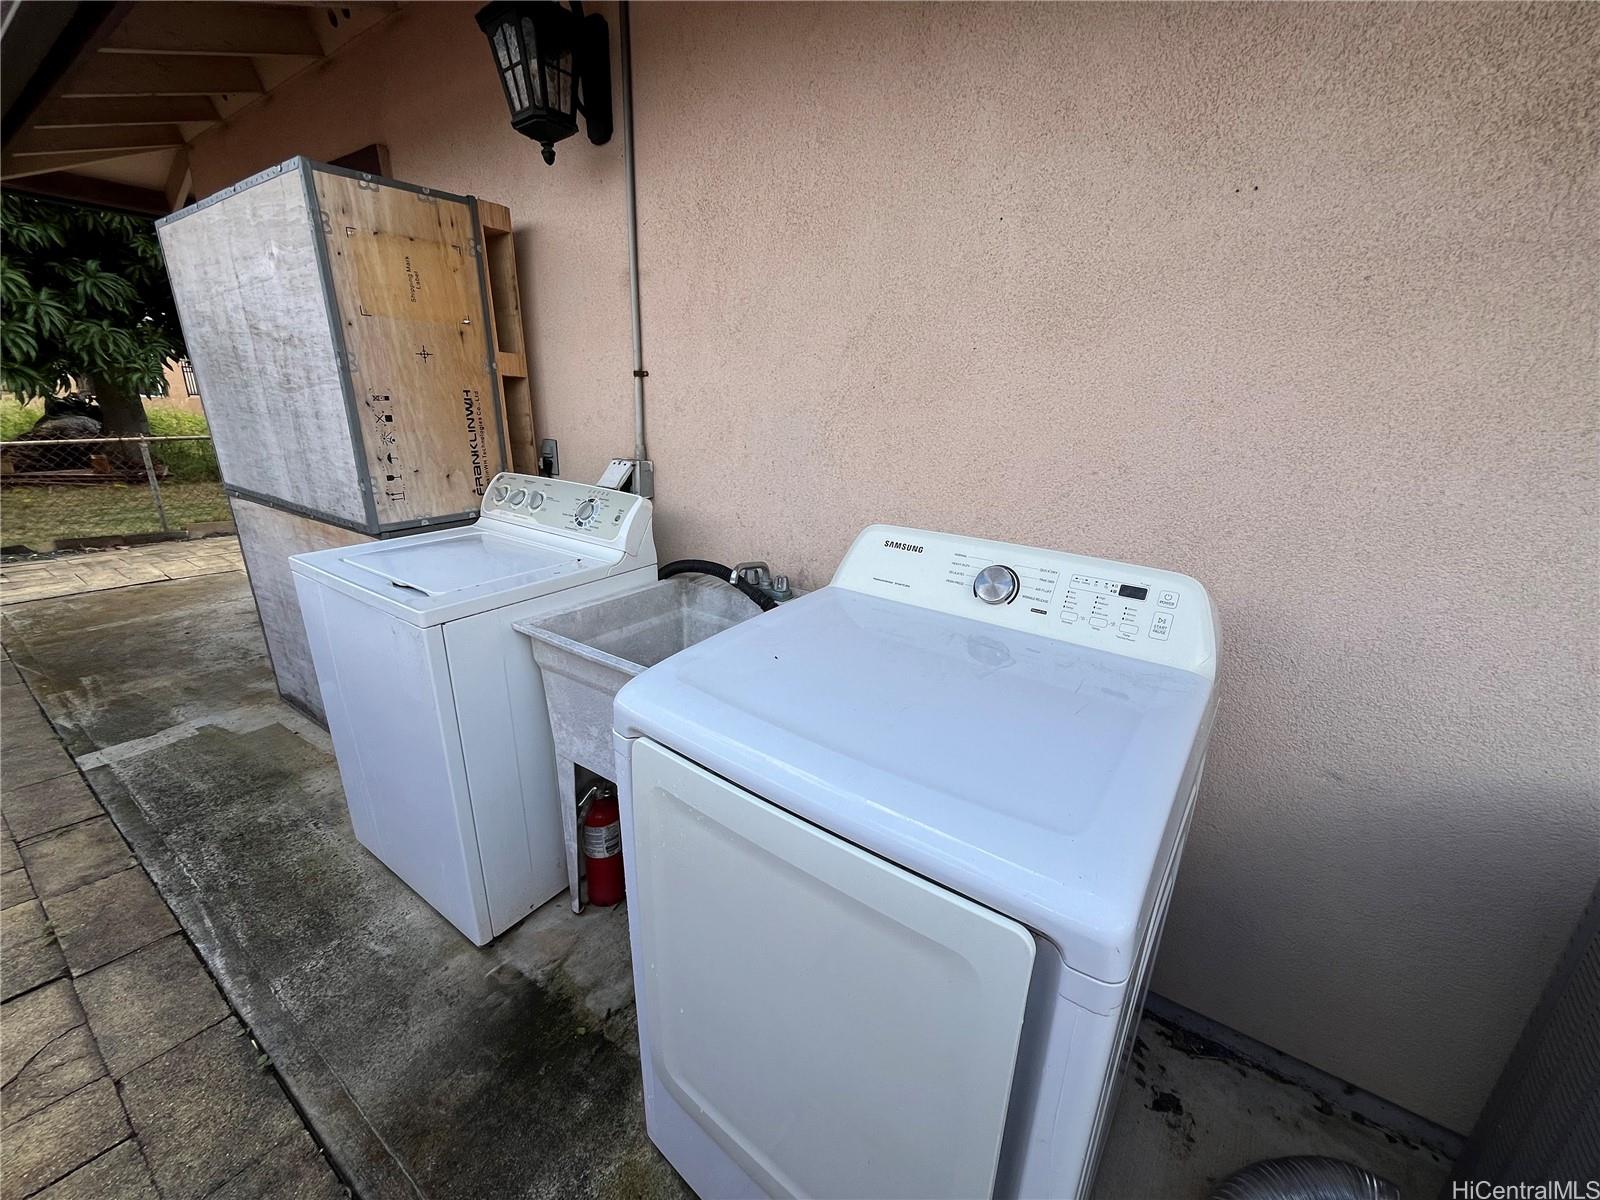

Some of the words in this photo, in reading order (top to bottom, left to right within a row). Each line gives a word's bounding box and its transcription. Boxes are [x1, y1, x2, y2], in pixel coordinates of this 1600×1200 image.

[408, 273, 417, 303] Shipping
[463, 389, 485, 497] FRANKLINWH
[883, 540, 924, 553] SAMSUNG
